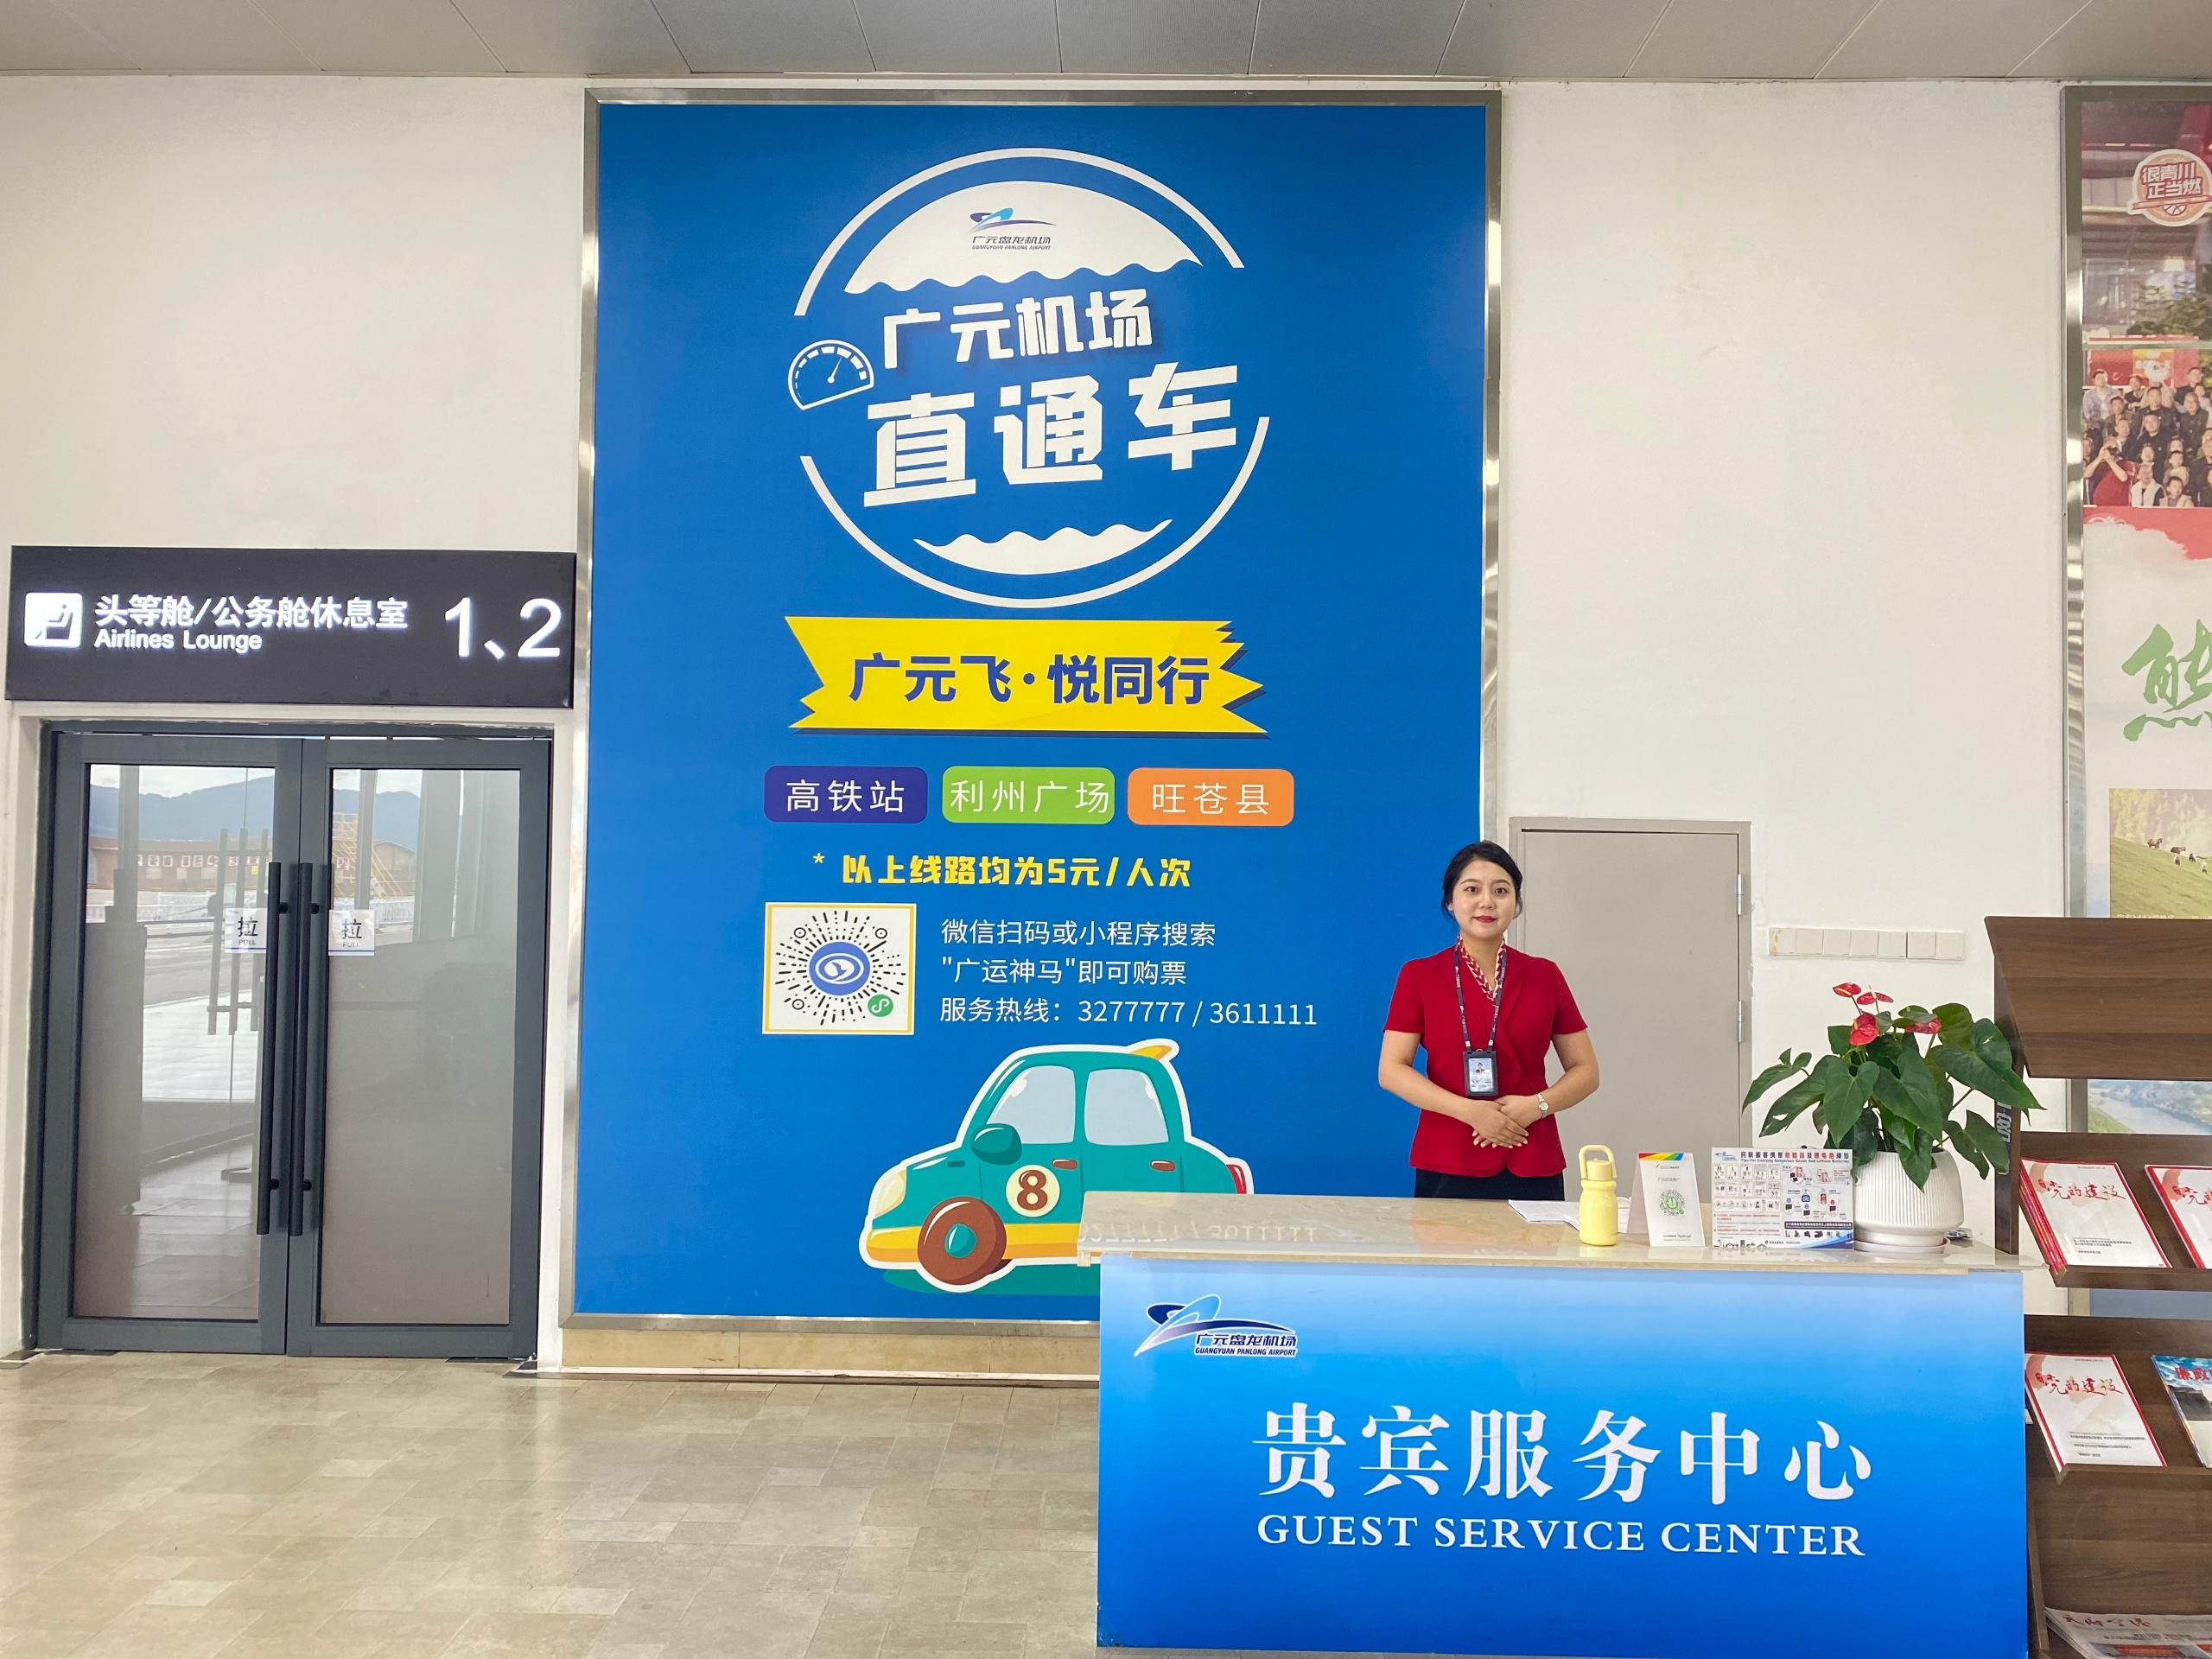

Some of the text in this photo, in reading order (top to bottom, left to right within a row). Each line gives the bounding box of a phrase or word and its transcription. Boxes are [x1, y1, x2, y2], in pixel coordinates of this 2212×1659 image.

[2147, 178, 2202, 199] 正当燃
[972, 235, 1052, 245] 广元盘龙机场
[882, 288, 1154, 370] 广元机场
[863, 361, 1238, 508] 直通车
[94, 594, 409, 631] 头等舱/公务舱休息室
[94, 628, 264, 655] Airlines Lounge
[848, 652, 1211, 707] 广元飞·悦同行
[785, 778, 906, 814] 高铁站
[949, 779, 1111, 814] 利州广场
[1151, 782, 1271, 817] 旺苍县
[842, 854, 1192, 887] 以上线路均为5元/人次
[237, 916, 258, 938] 拉
[341, 918, 363, 939] 拉
[941, 918, 1217, 947] 微信扫码或小程序搜索
[941, 956, 1187, 985] "广运神马"即可购票
[1077, 1000, 1185, 1023] 3277777
[1209, 1001, 1318, 1026] 3611111
[1016, 1169, 1048, 1211] 8
[1194, 1346, 1235, 1355] GUANGYUAN
[1236, 1347, 1267, 1356] PANLONG
[1195, 1333, 1297, 1347] 广元盘龙机场
[1252, 1402, 1872, 1505] 贵宾服务中心
[1256, 1513, 1866, 1557] GUEST SERVICE CENTER
